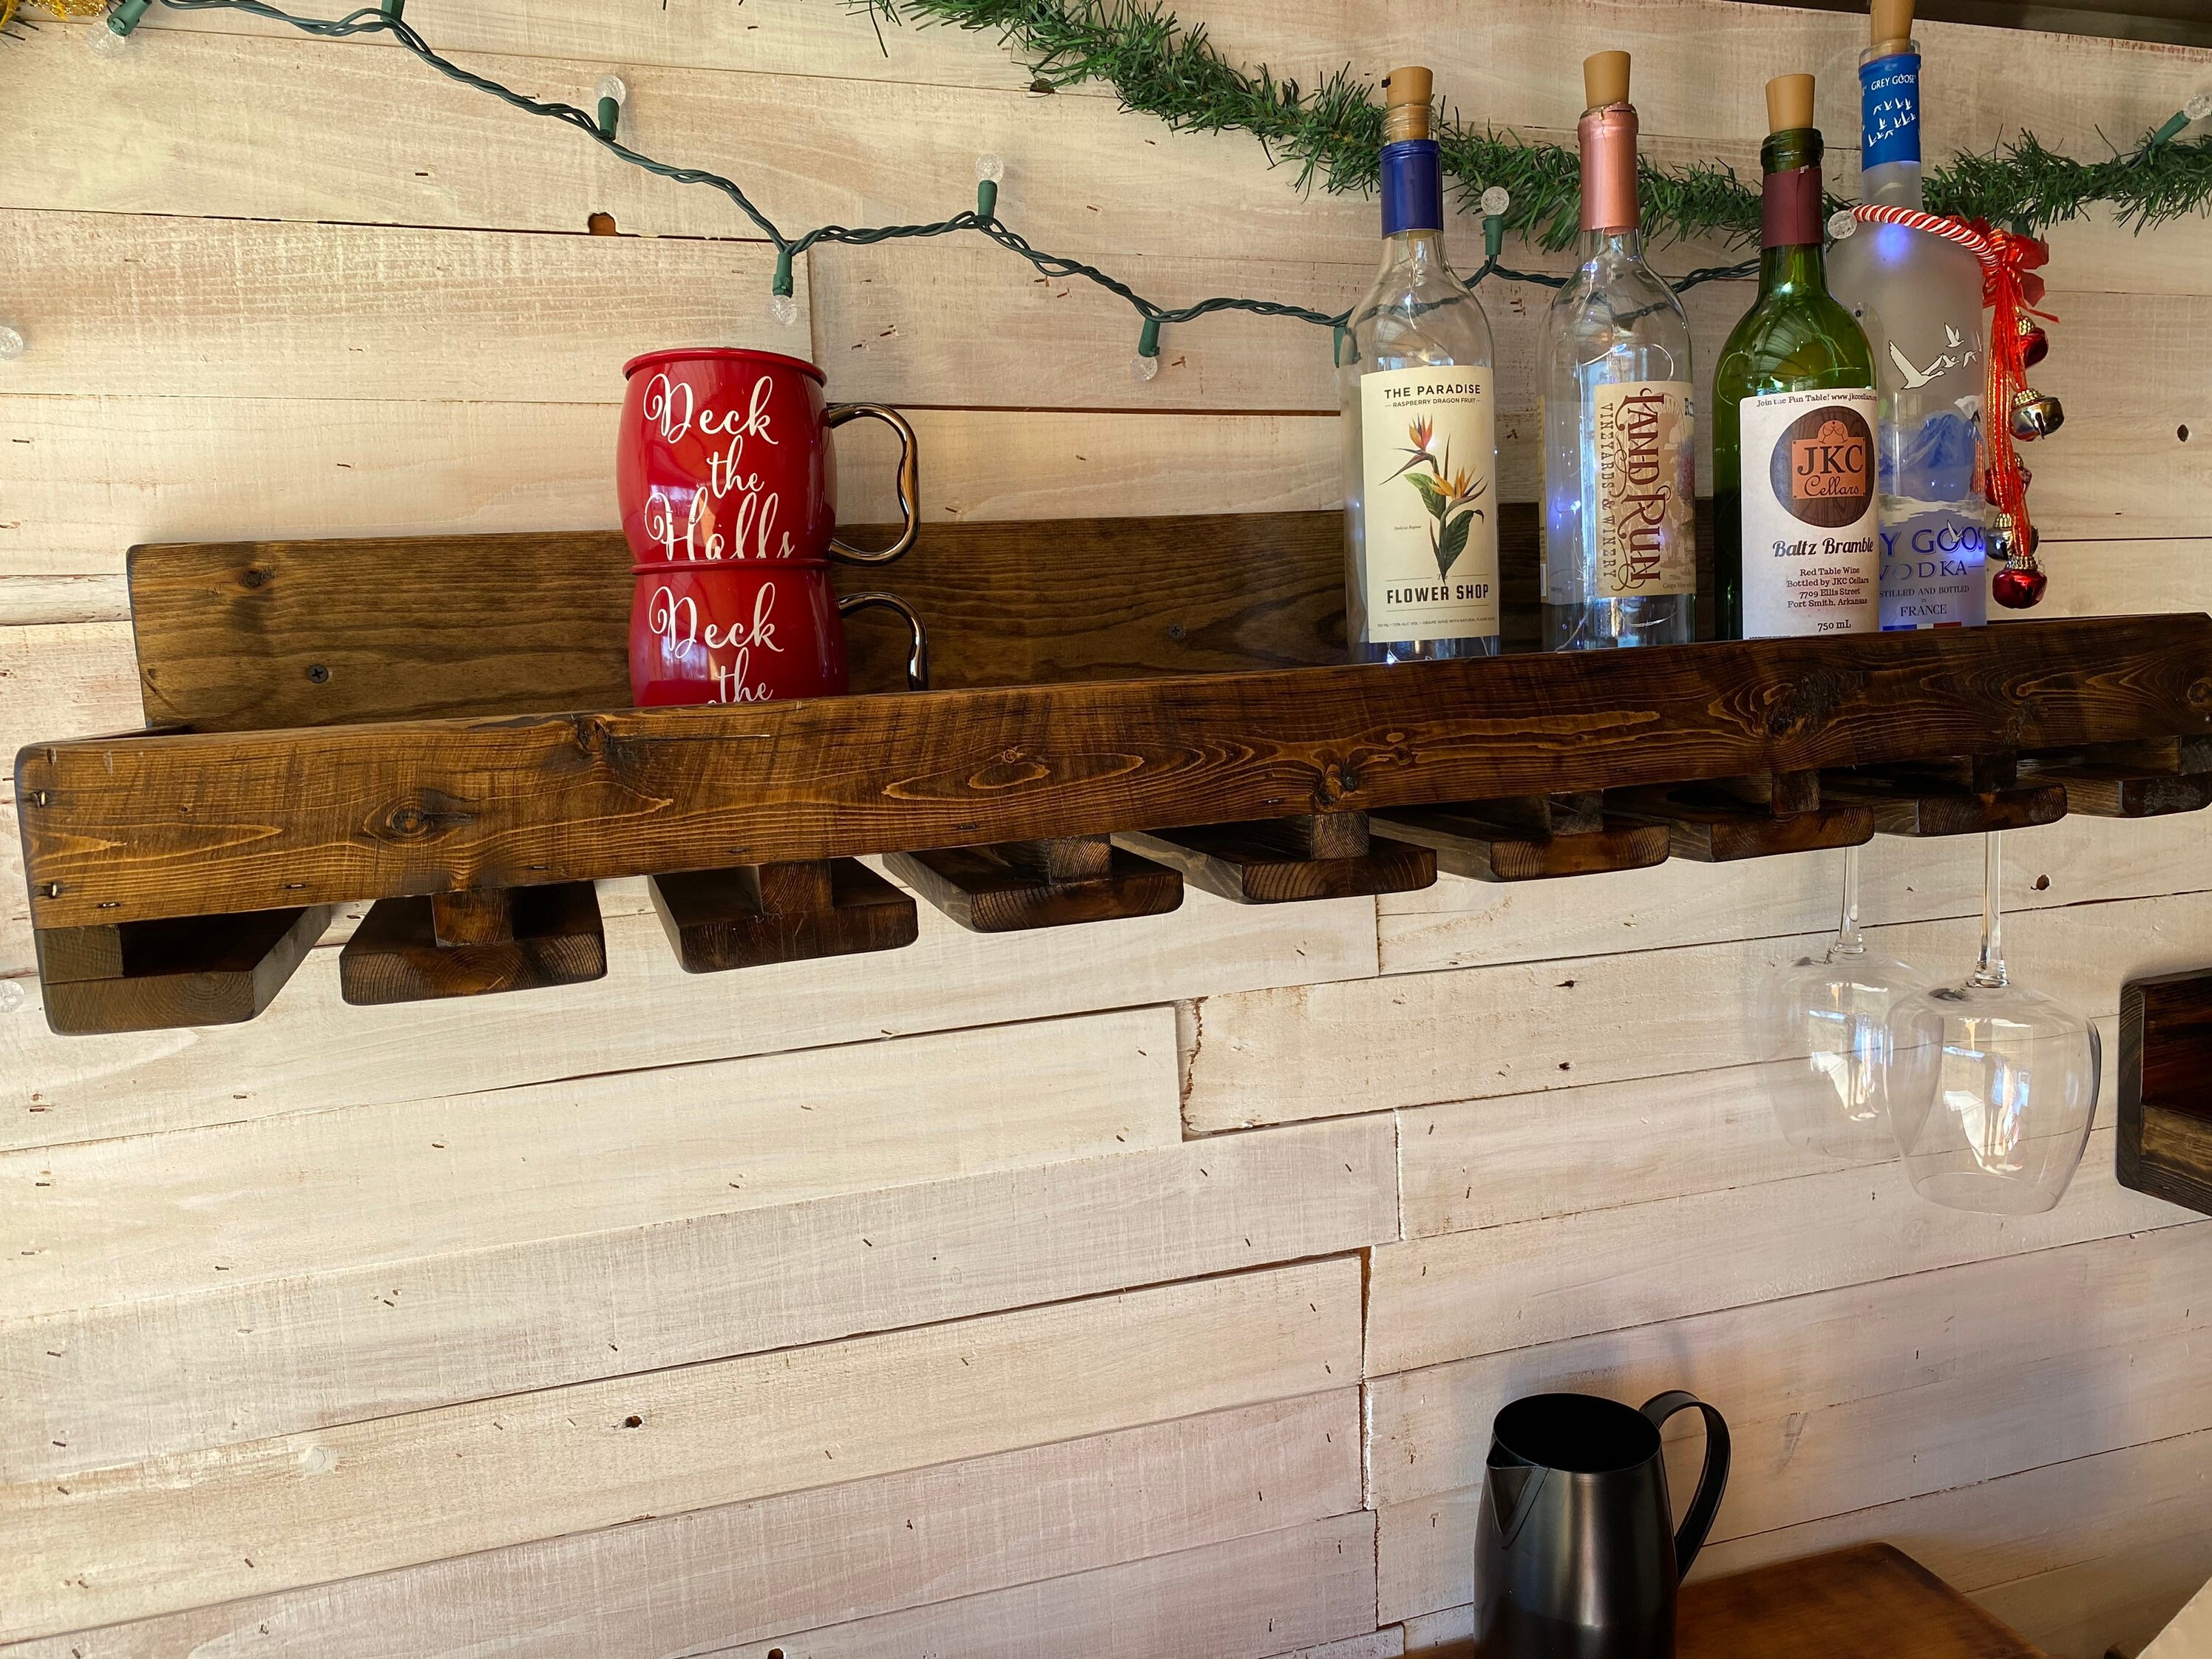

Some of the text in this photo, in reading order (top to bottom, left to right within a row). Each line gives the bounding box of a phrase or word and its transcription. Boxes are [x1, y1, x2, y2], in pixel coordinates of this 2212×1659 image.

[1871, 74, 1916, 90] GREY GOOSE
[1384, 384, 1480, 398] THE PARADISE
[1757, 398, 1772, 407] Join
[1788, 396, 1804, 404] Fun
[1805, 393, 1830, 401] Table!
[643, 373, 778, 444] Deck
[1393, 399, 1431, 407] RASPBERRY
[707, 435, 765, 498] the
[1797, 444, 1864, 475] JKC
[1600, 402, 1617, 578] VINEYARDS & WINERY
[1615, 387, 1672, 582] LAND RUN
[1804, 475, 1859, 496] Cellars
[644, 486, 795, 561] Halls
[1772, 540, 1817, 557] Baltz
[1822, 537, 1873, 554] Bramble
[1911, 526, 1987, 554] GOOS
[1842, 566, 1860, 574] Wine
[1786, 579, 1819, 588] Bottled
[1820, 579, 1831, 587] by
[1832, 577, 1848, 586] JKC
[1879, 588, 1915, 598] STILLED
[1938, 585, 1970, 594] BOTTLED
[1387, 583, 1489, 604] FLOWER SHOP
[1799, 591, 1819, 600] 7709
[1820, 588, 1839, 597] Ellis
[648, 582, 784, 659] Deck
[1900, 604, 1947, 617] FRANCE
[1817, 620, 1852, 632] 750 mL
[714, 647, 773, 703] the
